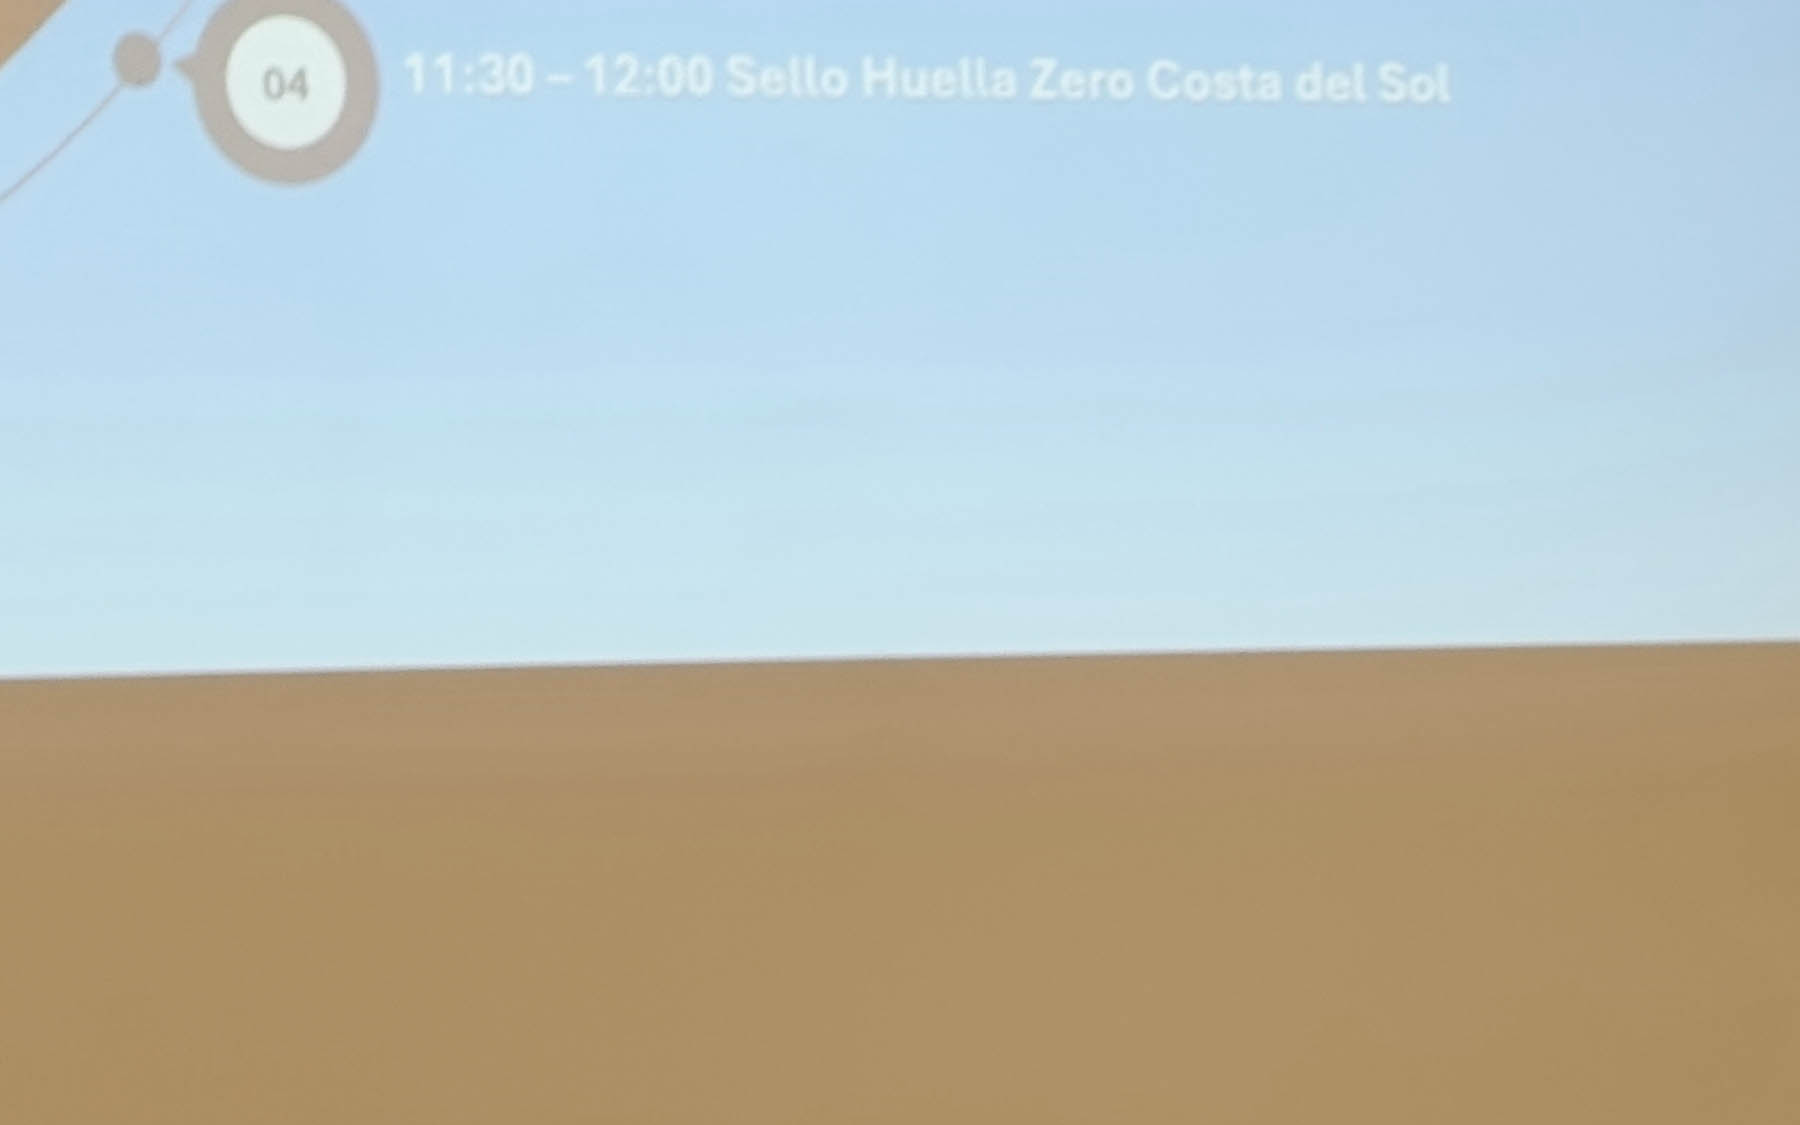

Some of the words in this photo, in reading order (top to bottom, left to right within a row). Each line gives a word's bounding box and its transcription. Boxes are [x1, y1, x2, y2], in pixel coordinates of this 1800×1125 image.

[263, 66, 309, 101] 04
[404, 52, 536, 96] 11:30
[583, 53, 714, 97] 12:00
[725, 54, 849, 99] Sello
[862, 55, 1018, 99] Huella
[1030, 58, 1135, 101] Zero
[1146, 59, 1283, 102] Costa
[1296, 62, 1367, 102] del
[1376, 62, 1452, 104] Sol
